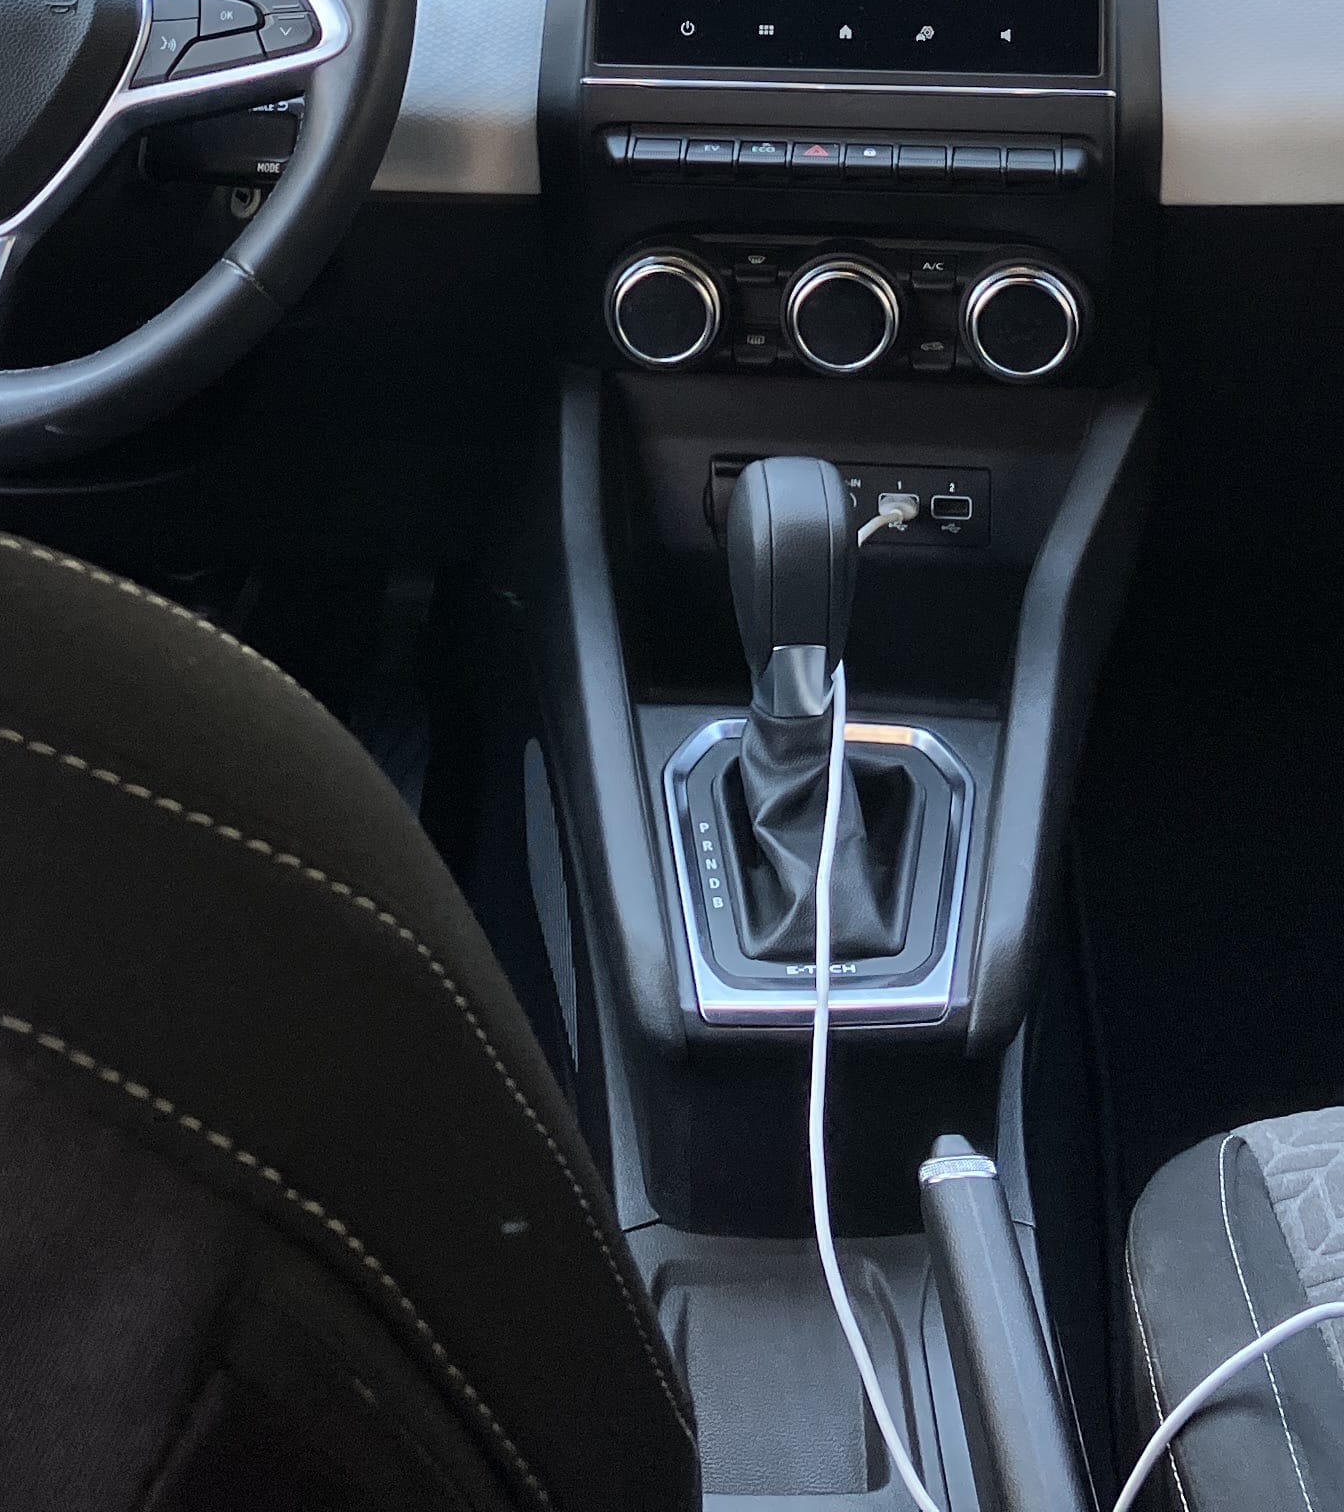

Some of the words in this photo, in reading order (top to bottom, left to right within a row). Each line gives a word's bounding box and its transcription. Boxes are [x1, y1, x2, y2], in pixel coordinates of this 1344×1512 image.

[220, 10, 234, 21] OK
[256, 162, 280, 173] MODE
[922, 261, 944, 271] A/C
[897, 480, 902, 490] 1
[948, 482, 955, 493] 2
[700, 823, 710, 834] P
[702, 841, 713, 852] R
[706, 859, 717, 870] N
[709, 877, 720, 889] D
[713, 897, 724, 909] B
[786, 963, 857, 975] E-TCH
